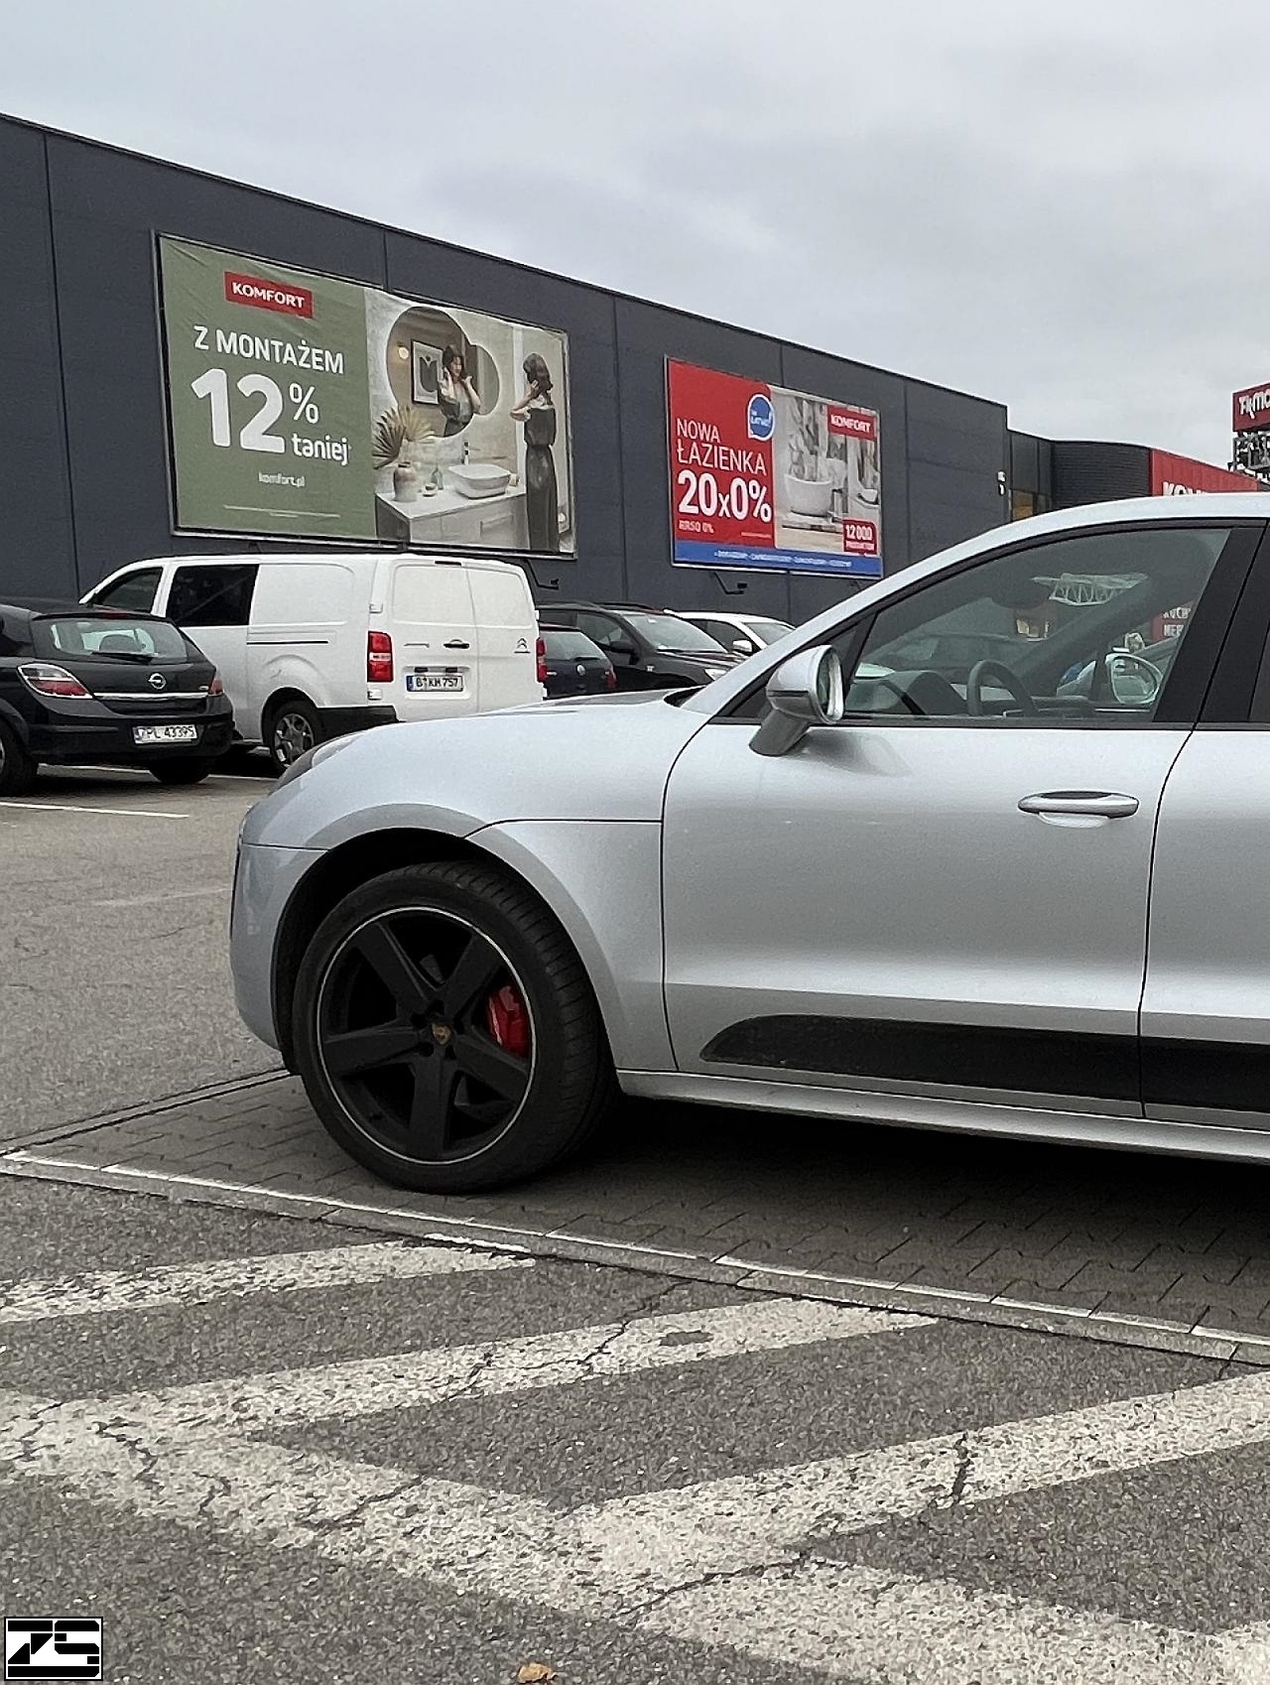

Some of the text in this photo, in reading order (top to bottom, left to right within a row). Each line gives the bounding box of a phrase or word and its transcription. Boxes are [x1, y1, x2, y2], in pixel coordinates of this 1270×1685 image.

[232, 281, 305, 309] KOMFORT
[193, 325, 345, 375] Z MONTAŻEM
[676, 418, 721, 443] NOWA
[291, 432, 349, 467] taniej
[676, 439, 767, 477] ŁAZIENKA
